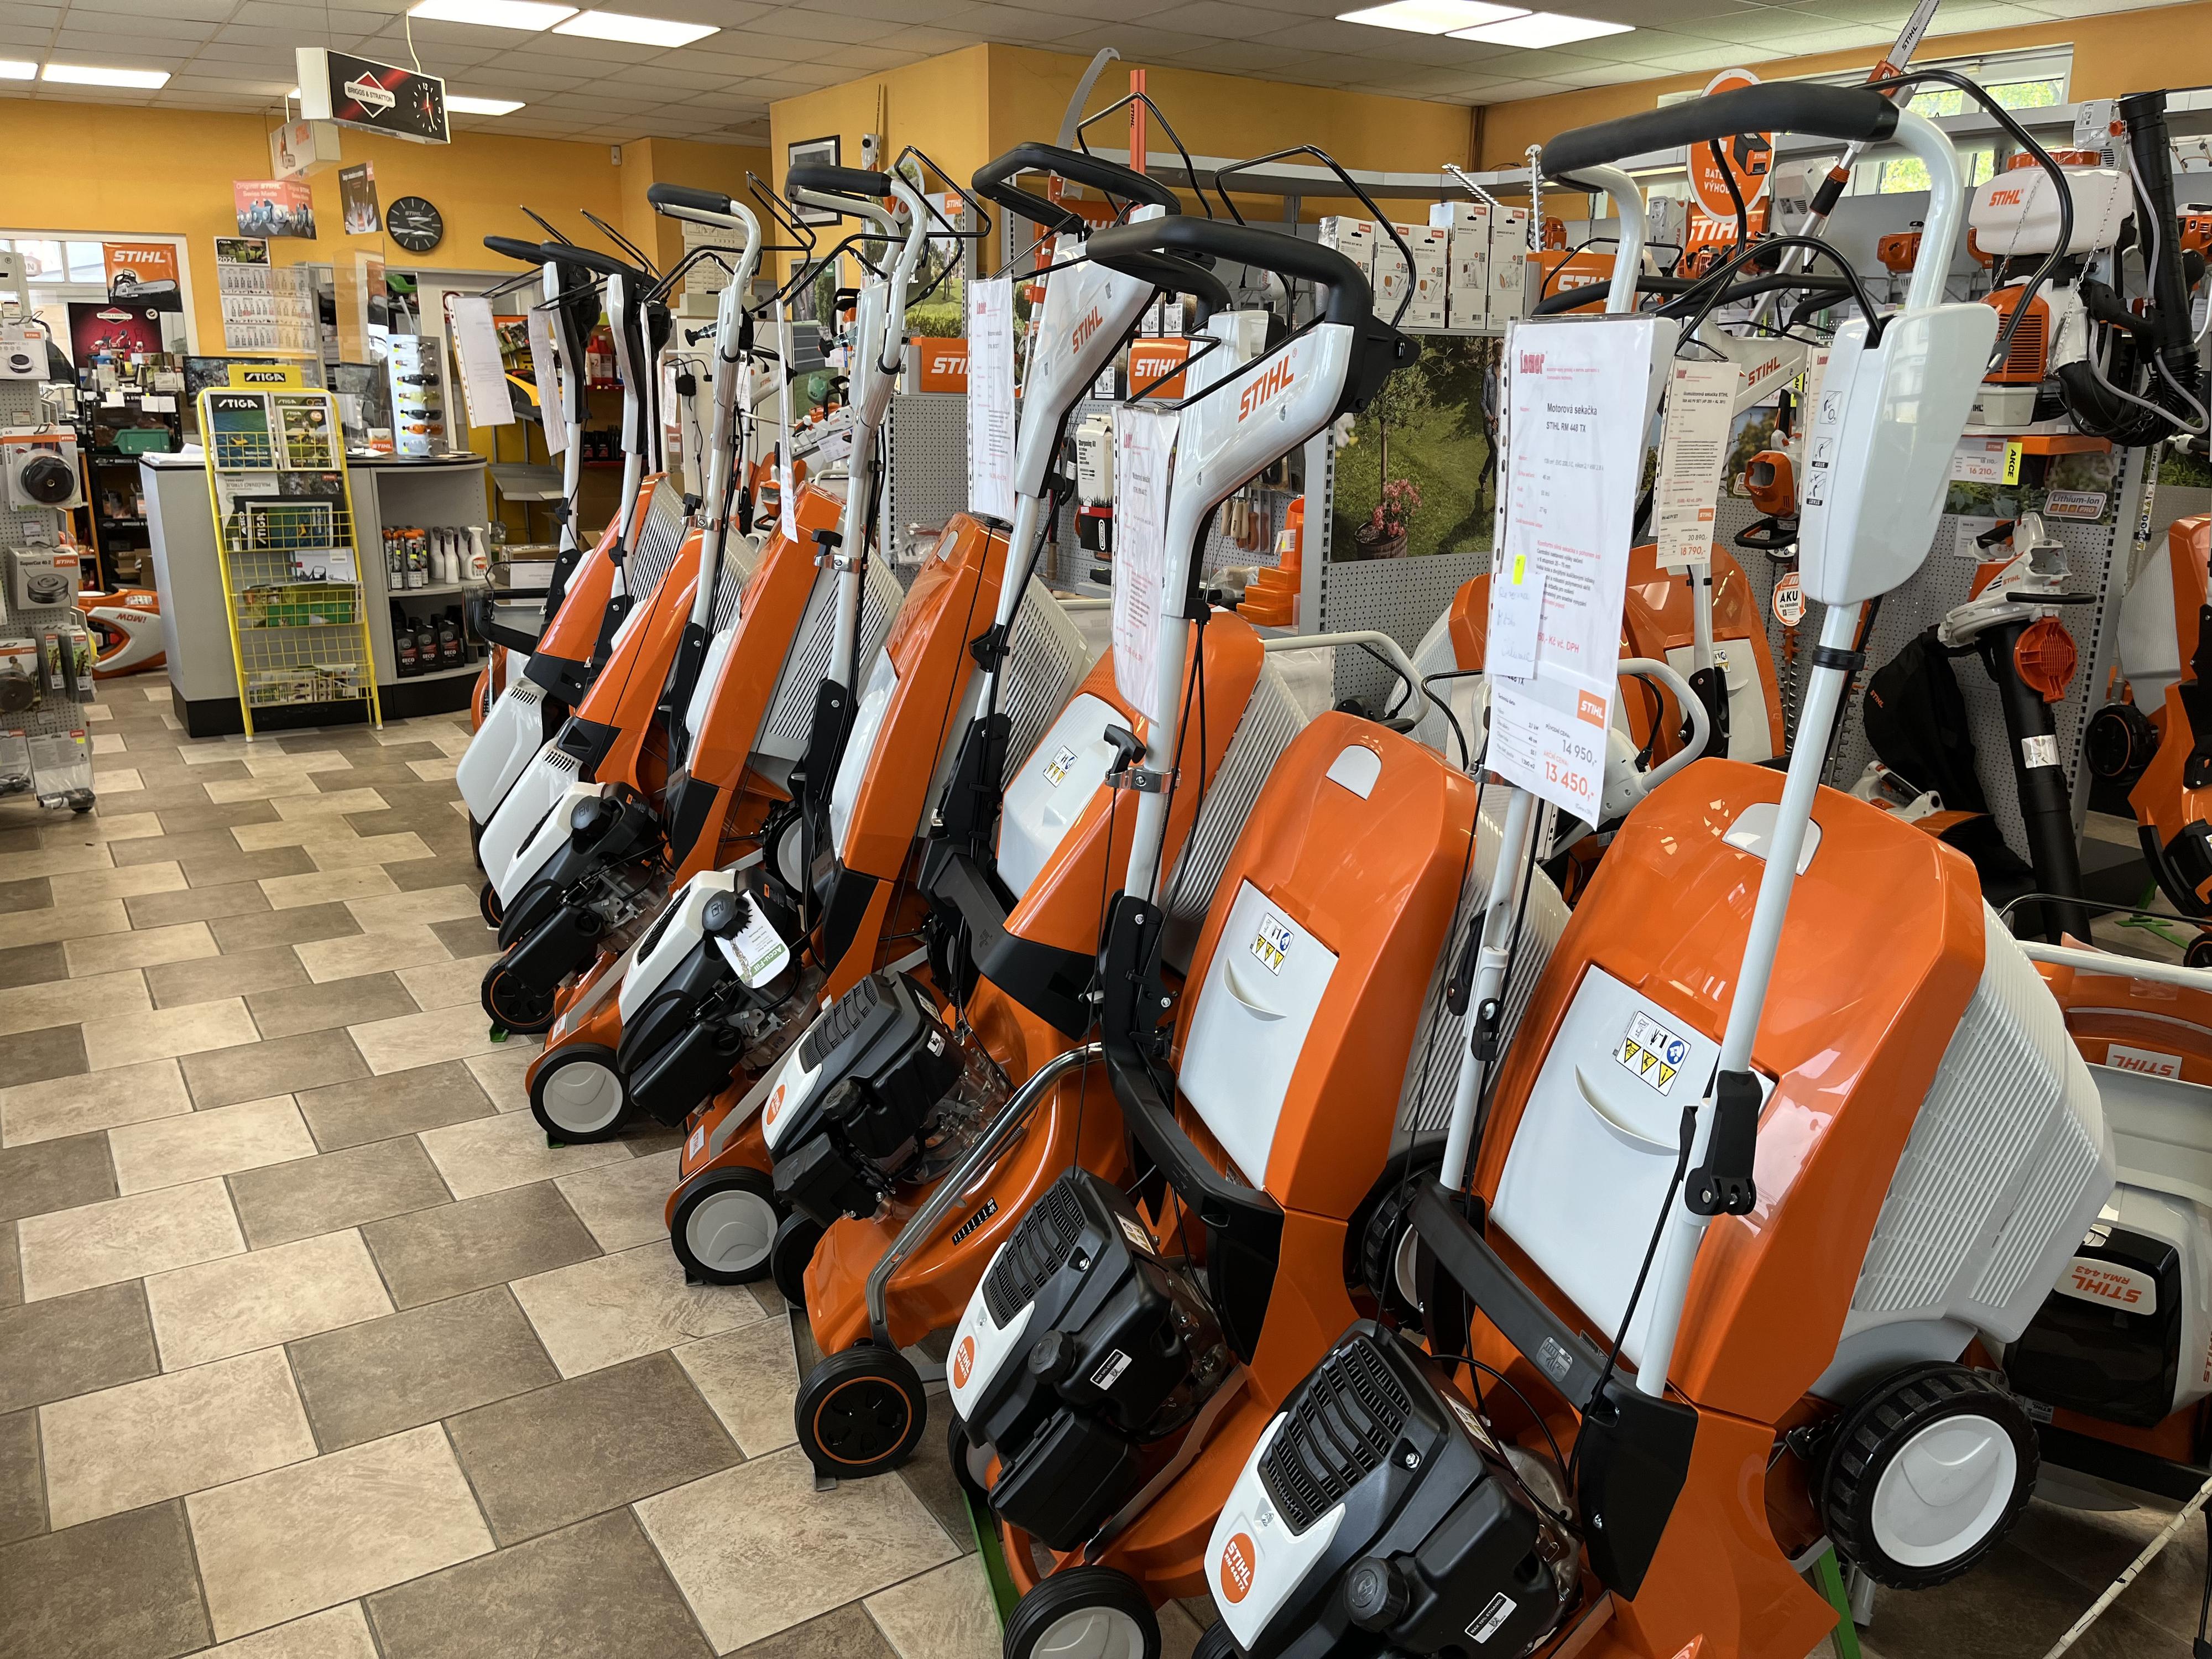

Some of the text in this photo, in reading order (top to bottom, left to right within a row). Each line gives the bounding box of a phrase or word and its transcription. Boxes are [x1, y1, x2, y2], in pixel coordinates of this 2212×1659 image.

[347, 86, 366, 96] BRIGGS
[369, 92, 393, 102] STRATTON
[946, 199, 962, 208] STIHL
[1989, 189, 2020, 206] STIHL
[113, 250, 166, 263] STIHL
[1072, 305, 1103, 354] STIHL
[931, 357, 968, 374] STI
[1135, 359, 1181, 377] STIHL
[1748, 356, 1781, 387] STIHL
[246, 373, 285, 382] STIGA
[1238, 355, 1295, 422] STIHL
[218, 399, 258, 409] STIGA
[1547, 403, 1597, 415] Motorová sekačka
[1546, 421, 1559, 431] STIHL
[1561, 422, 1569, 431] RM
[2007, 448, 2016, 478] AKCE
[2052, 494, 2100, 504] Lithium-Ion
[1681, 547, 1687, 556] 18
[2002, 575, 2021, 585] STIHL
[1780, 590, 1798, 603] AKU
[1548, 637, 1556, 645] Kč
[1566, 641, 1579, 653] DPH
[1870, 690, 1884, 708] STIHL
[1580, 700, 1603, 719] STIHL
[1562, 739, 1572, 755] 14
[1546, 760, 1594, 801] 13 450,-
[754, 944, 783, 972] Accu-Fill
[2112, 1055, 2175, 1076] STIHL
[2075, 1265, 2130, 1285] RMA 443
[2071, 1274, 2142, 1303] STIHL
[958, 1342, 971, 1374] STIHL
[1224, 1552, 1245, 1593] RM 448 TX
[1227, 1541, 1250, 1586] STIHL
[1470, 1624, 1480, 1634] MAX
[1486, 1598, 1503, 1617] ETHANOL
